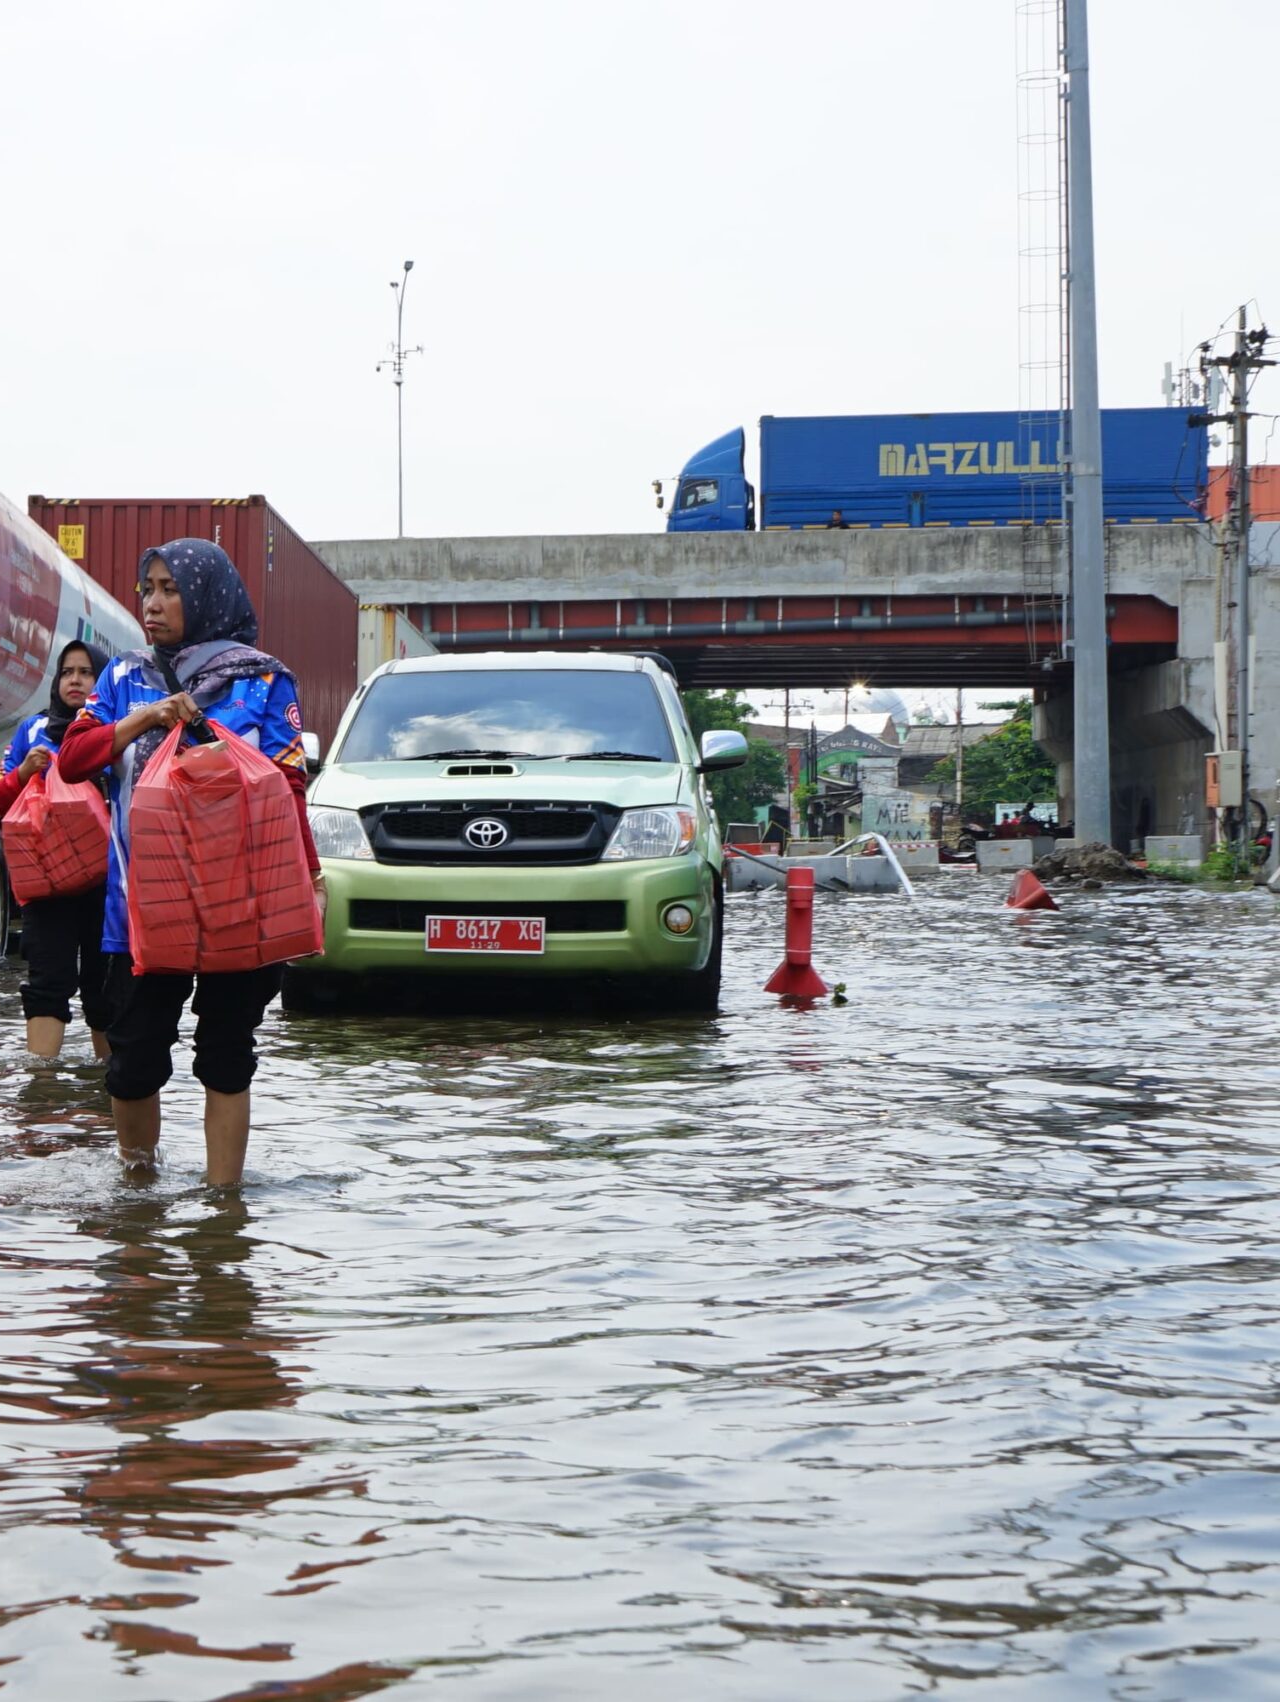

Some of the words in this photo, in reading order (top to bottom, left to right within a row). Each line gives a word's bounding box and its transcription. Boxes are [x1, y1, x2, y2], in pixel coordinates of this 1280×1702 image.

[878, 440, 1065, 477] MARZULL
[876, 808, 910, 825] MIE
[429, 919, 441, 939] H
[455, 919, 502, 940] 8617
[518, 920, 541, 941] XG
